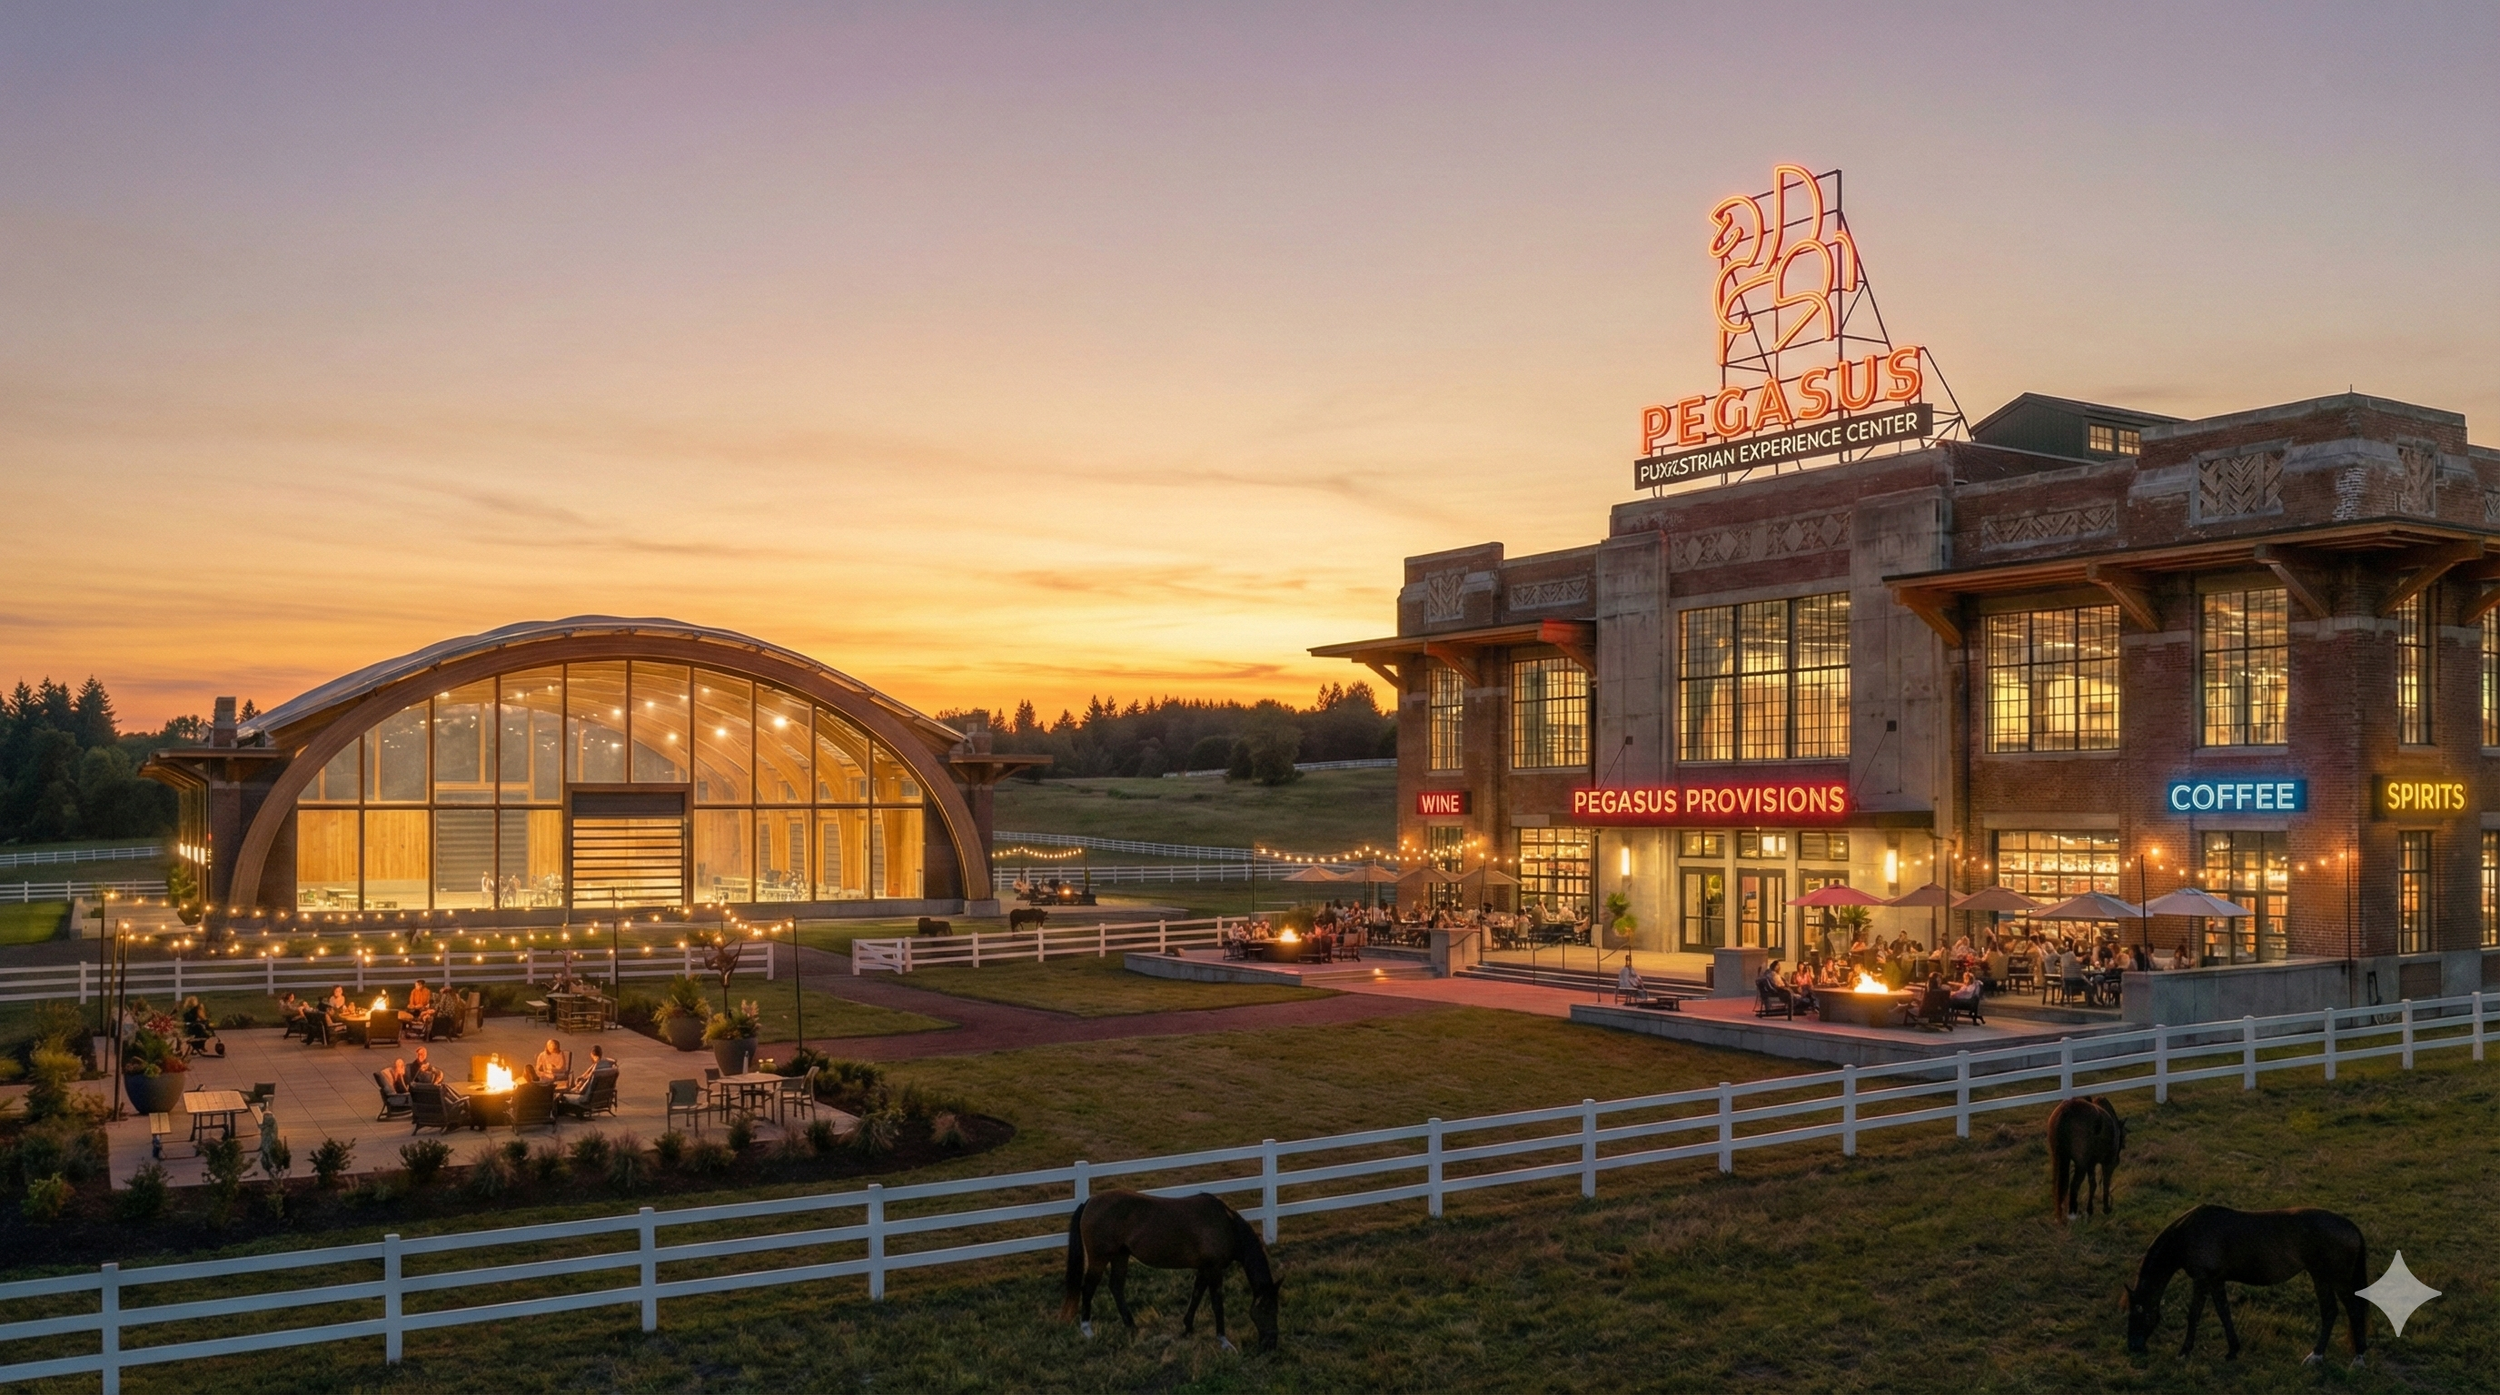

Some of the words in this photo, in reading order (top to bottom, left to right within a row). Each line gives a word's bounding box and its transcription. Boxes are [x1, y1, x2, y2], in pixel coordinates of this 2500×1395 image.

[1641, 346, 1922, 455] PEGASUS
[1740, 427, 1841, 463] EXPERIENCE
[1847, 412, 1918, 442] CENTER
[1422, 794, 1460, 813] WINE
[1574, 789, 1677, 814] PEGASUS
[1686, 786, 1845, 814] PROVISIONS
[2171, 783, 2295, 811] COFFEE
[2387, 782, 2465, 810] SPIRITS
